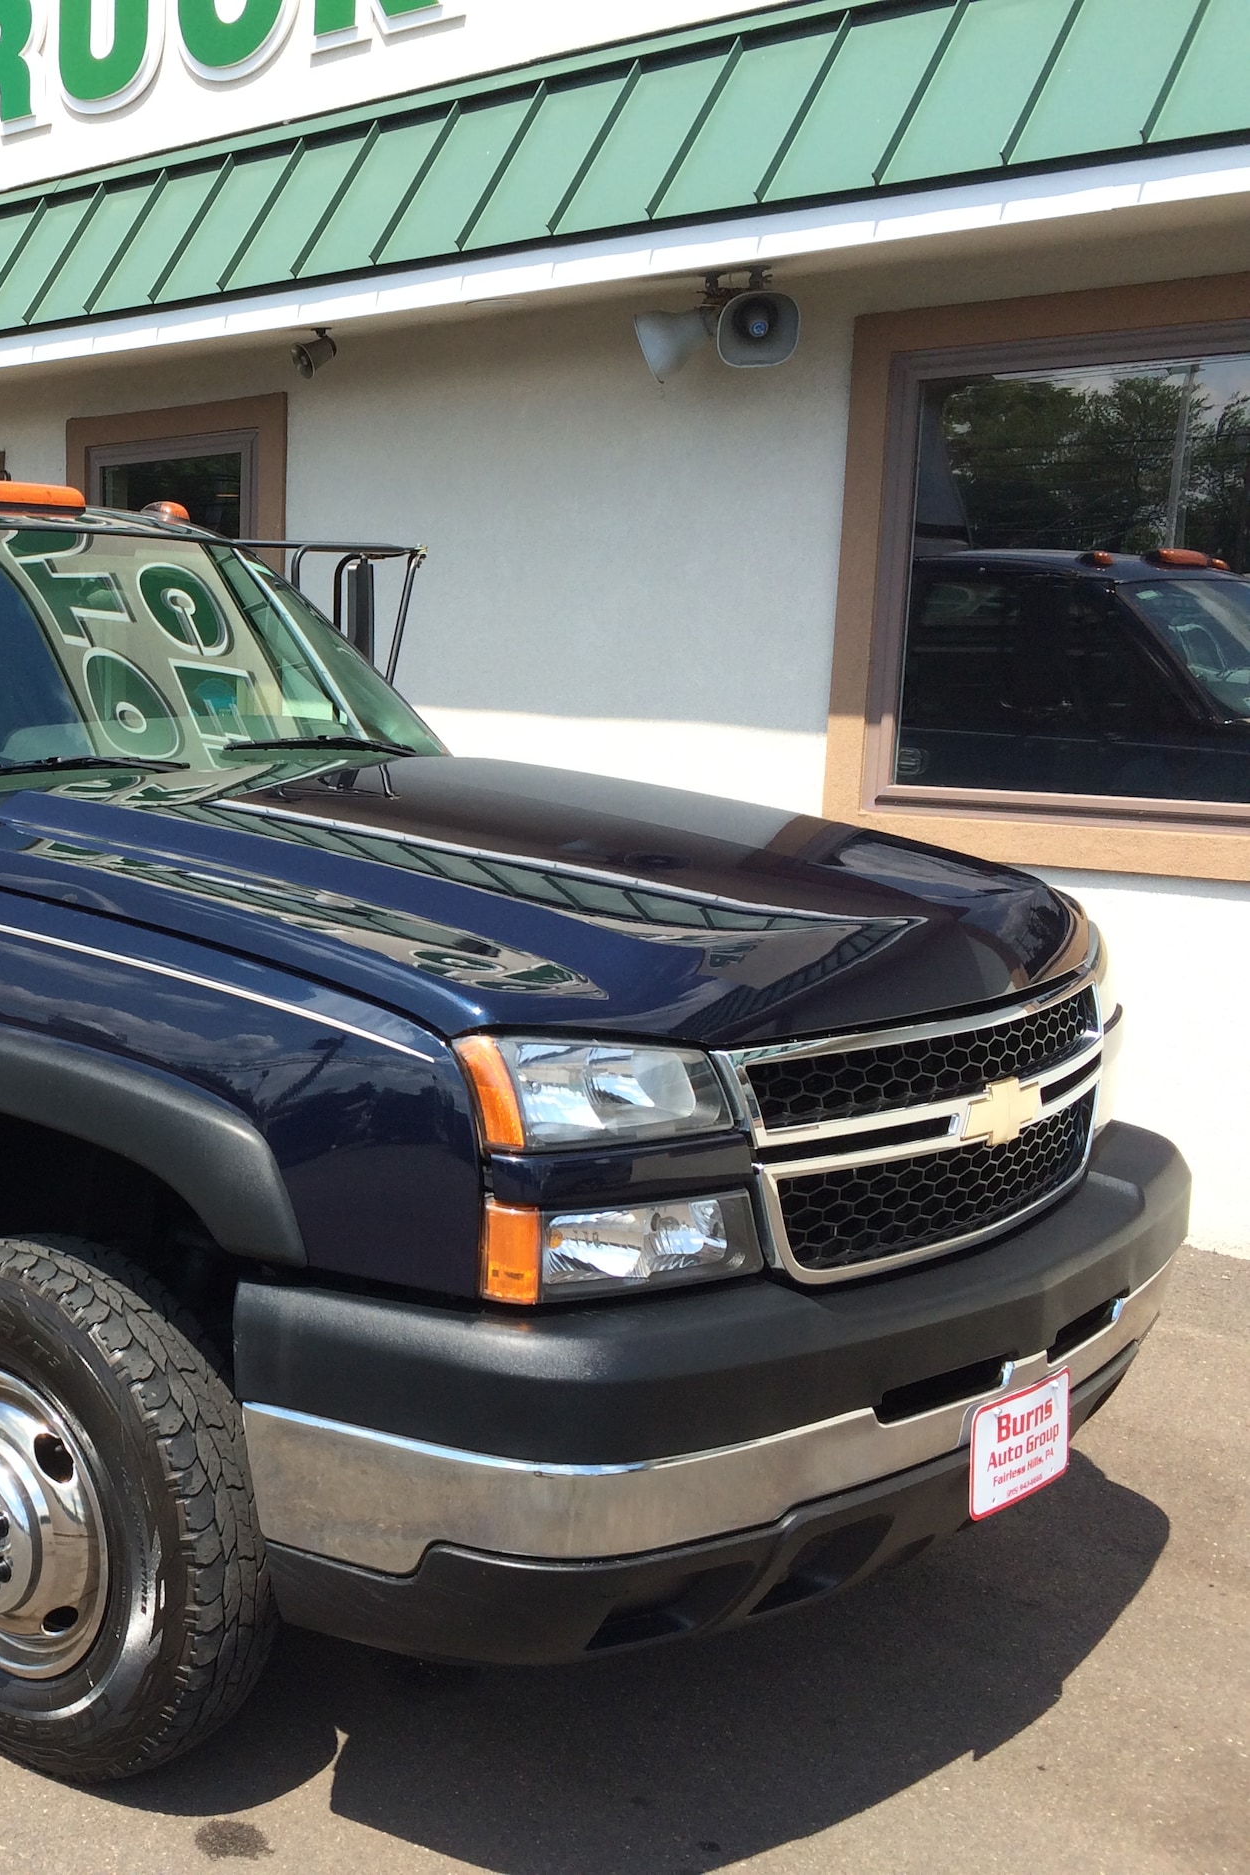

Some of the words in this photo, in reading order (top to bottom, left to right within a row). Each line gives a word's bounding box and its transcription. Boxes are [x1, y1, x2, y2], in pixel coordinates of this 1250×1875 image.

[997, 1398, 1053, 1443] Burns
[988, 1445, 1022, 1471] Auto
[1026, 1424, 1059, 1454] Group
[993, 1465, 1026, 1487] Fairless
